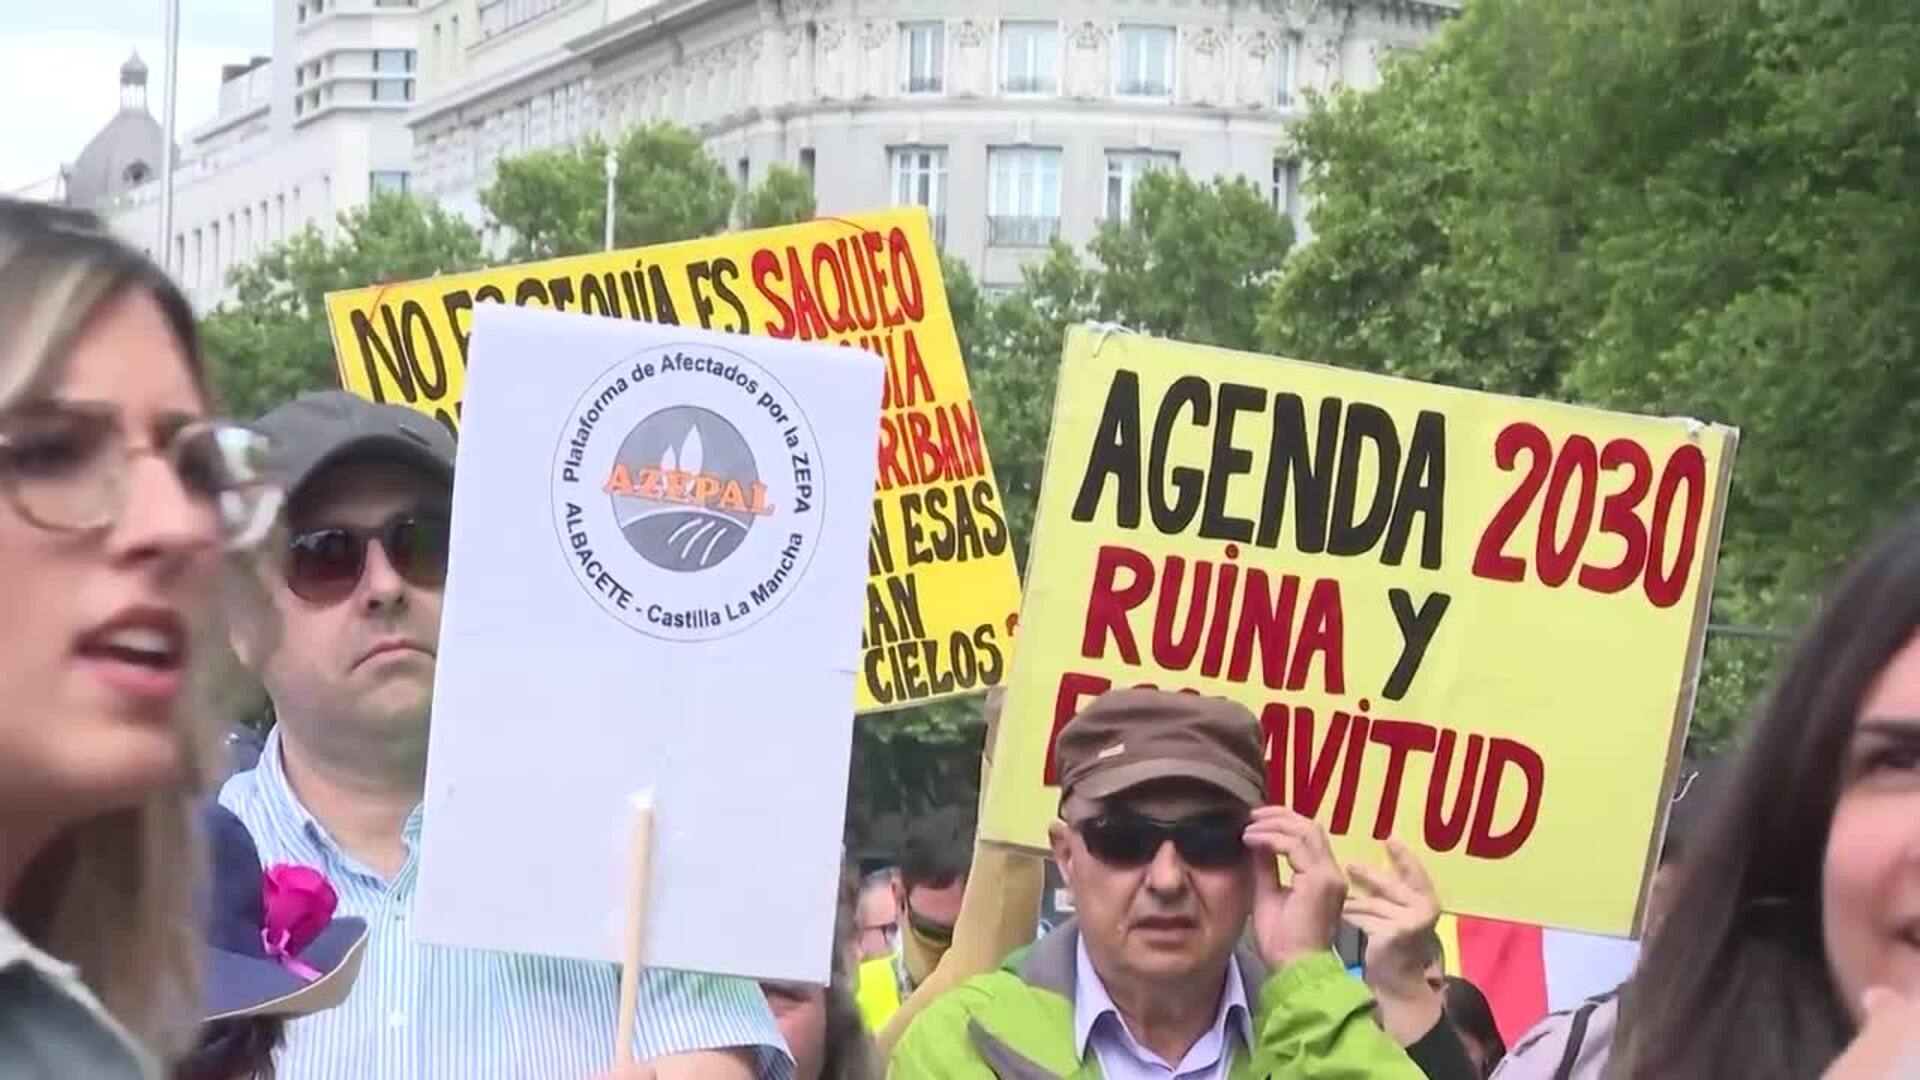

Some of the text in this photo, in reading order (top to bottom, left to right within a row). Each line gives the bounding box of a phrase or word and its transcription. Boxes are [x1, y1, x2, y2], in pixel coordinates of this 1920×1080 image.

[350, 298, 447, 404] NO
[442, 287, 506, 374] E
[686, 257, 750, 335] ES
[750, 226, 925, 342] SAQUEO
[563, 351, 813, 514] Plataforma de Afectados por la ZEPA
[602, 463, 775, 516] AZEPAL
[874, 400, 985, 491] RIBAN
[1071, 369, 1706, 609] AGENDA 2030
[565, 501, 634, 611] ALBACETE
[647, 603, 722, 629] Castilla
[724, 600, 751, 622] La
[749, 532, 803, 606] Mancha
[899, 480, 1008, 567] ESAS
[861, 572, 927, 650] AN
[863, 623, 1005, 705] CIELOS
[1081, 544, 1452, 702] RUINA Y
[1043, 671, 1546, 861] EAVITUD
